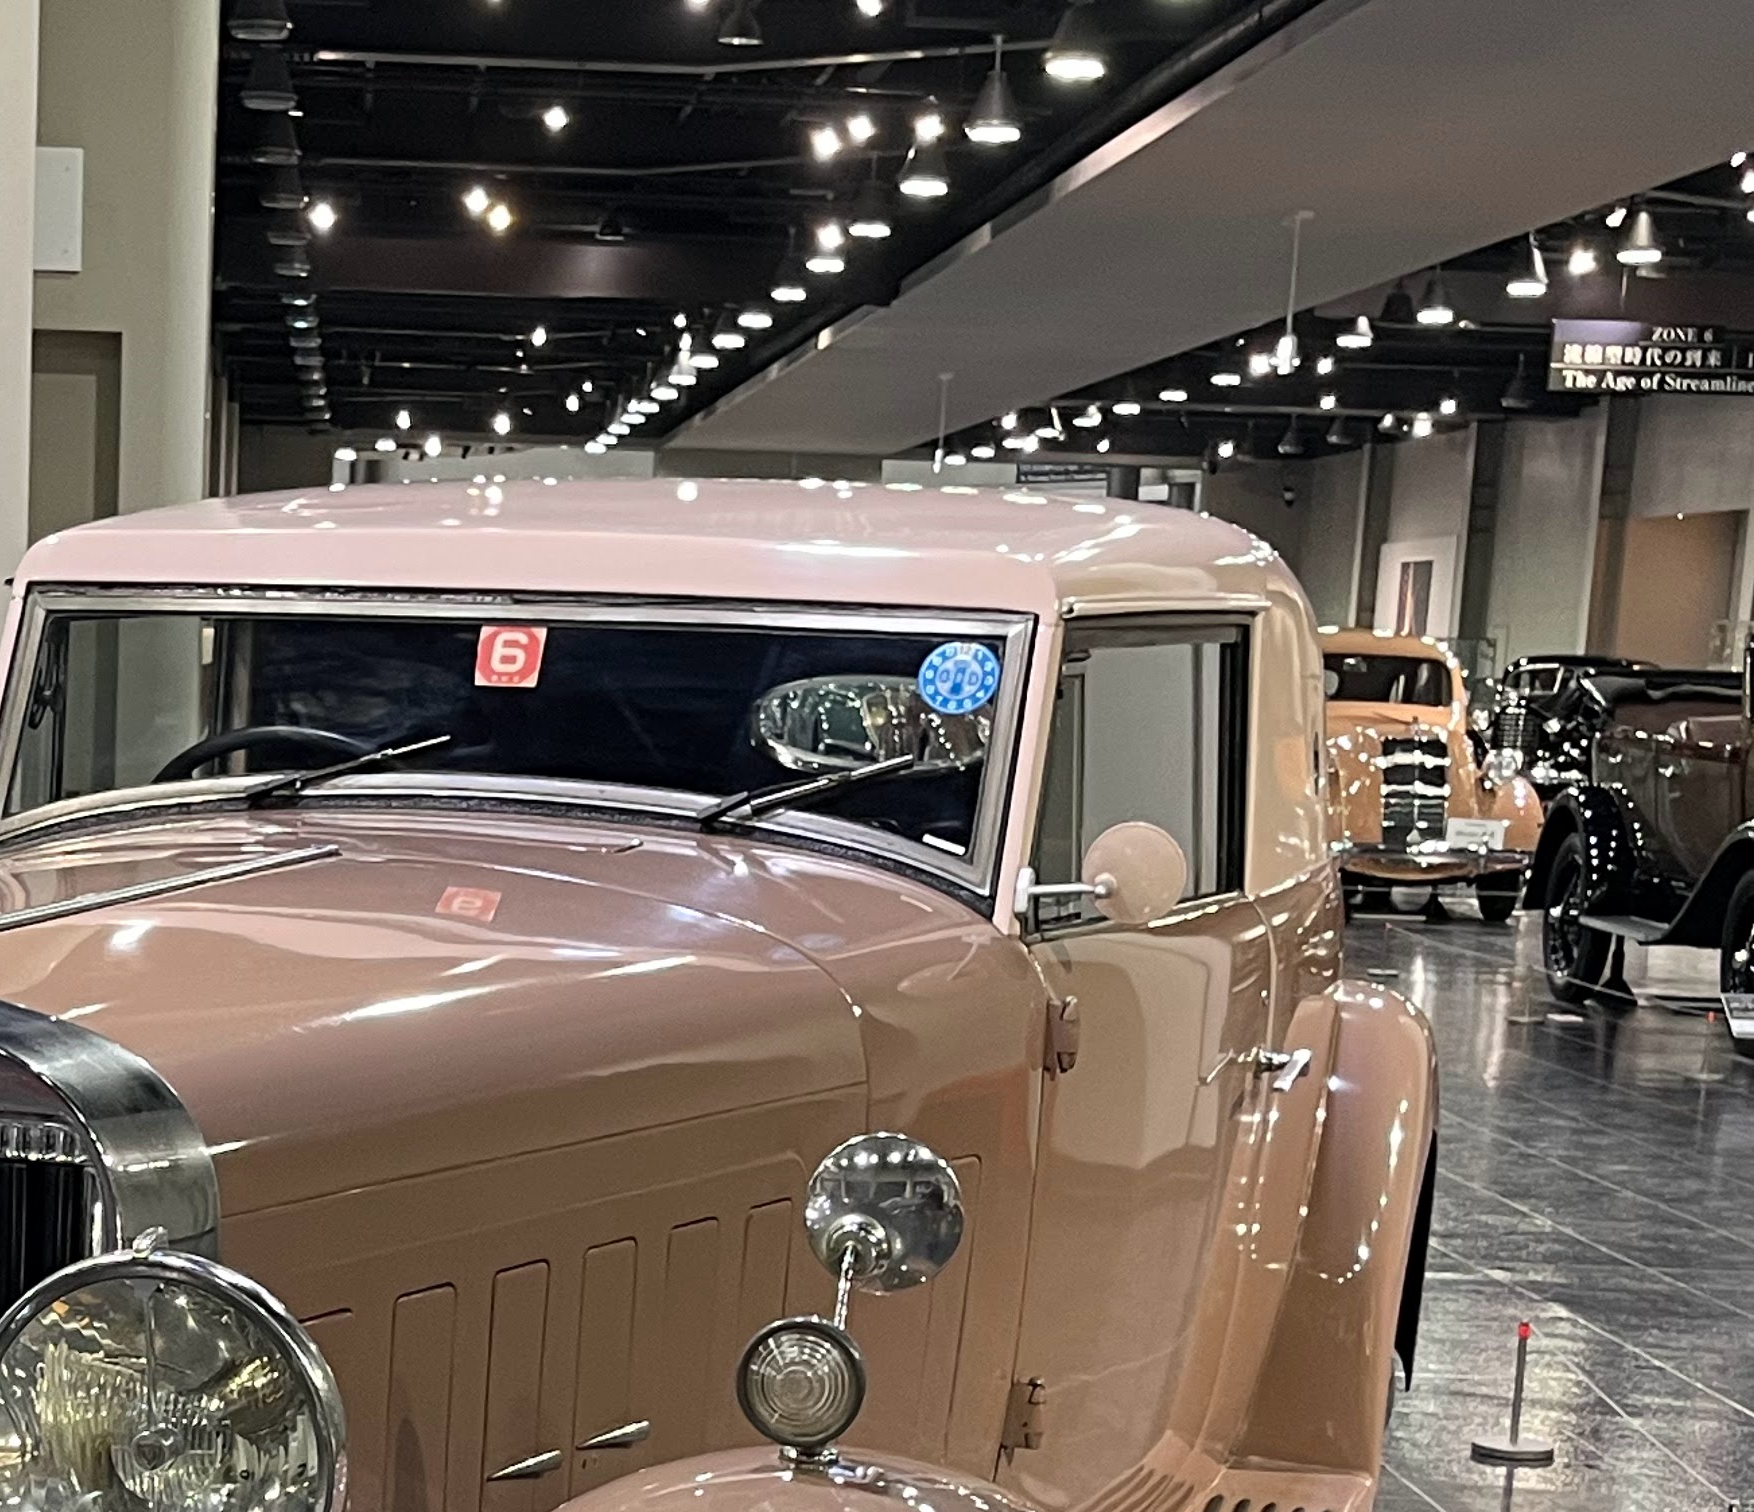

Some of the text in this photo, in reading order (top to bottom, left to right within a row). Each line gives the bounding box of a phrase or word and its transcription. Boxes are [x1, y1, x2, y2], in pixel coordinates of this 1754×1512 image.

[1651, 326, 1696, 343] ZONE
[1562, 369, 1597, 389] The
[1601, 371, 1637, 392] Age
[1640, 372, 1661, 391] of
[490, 631, 529, 673] 6
